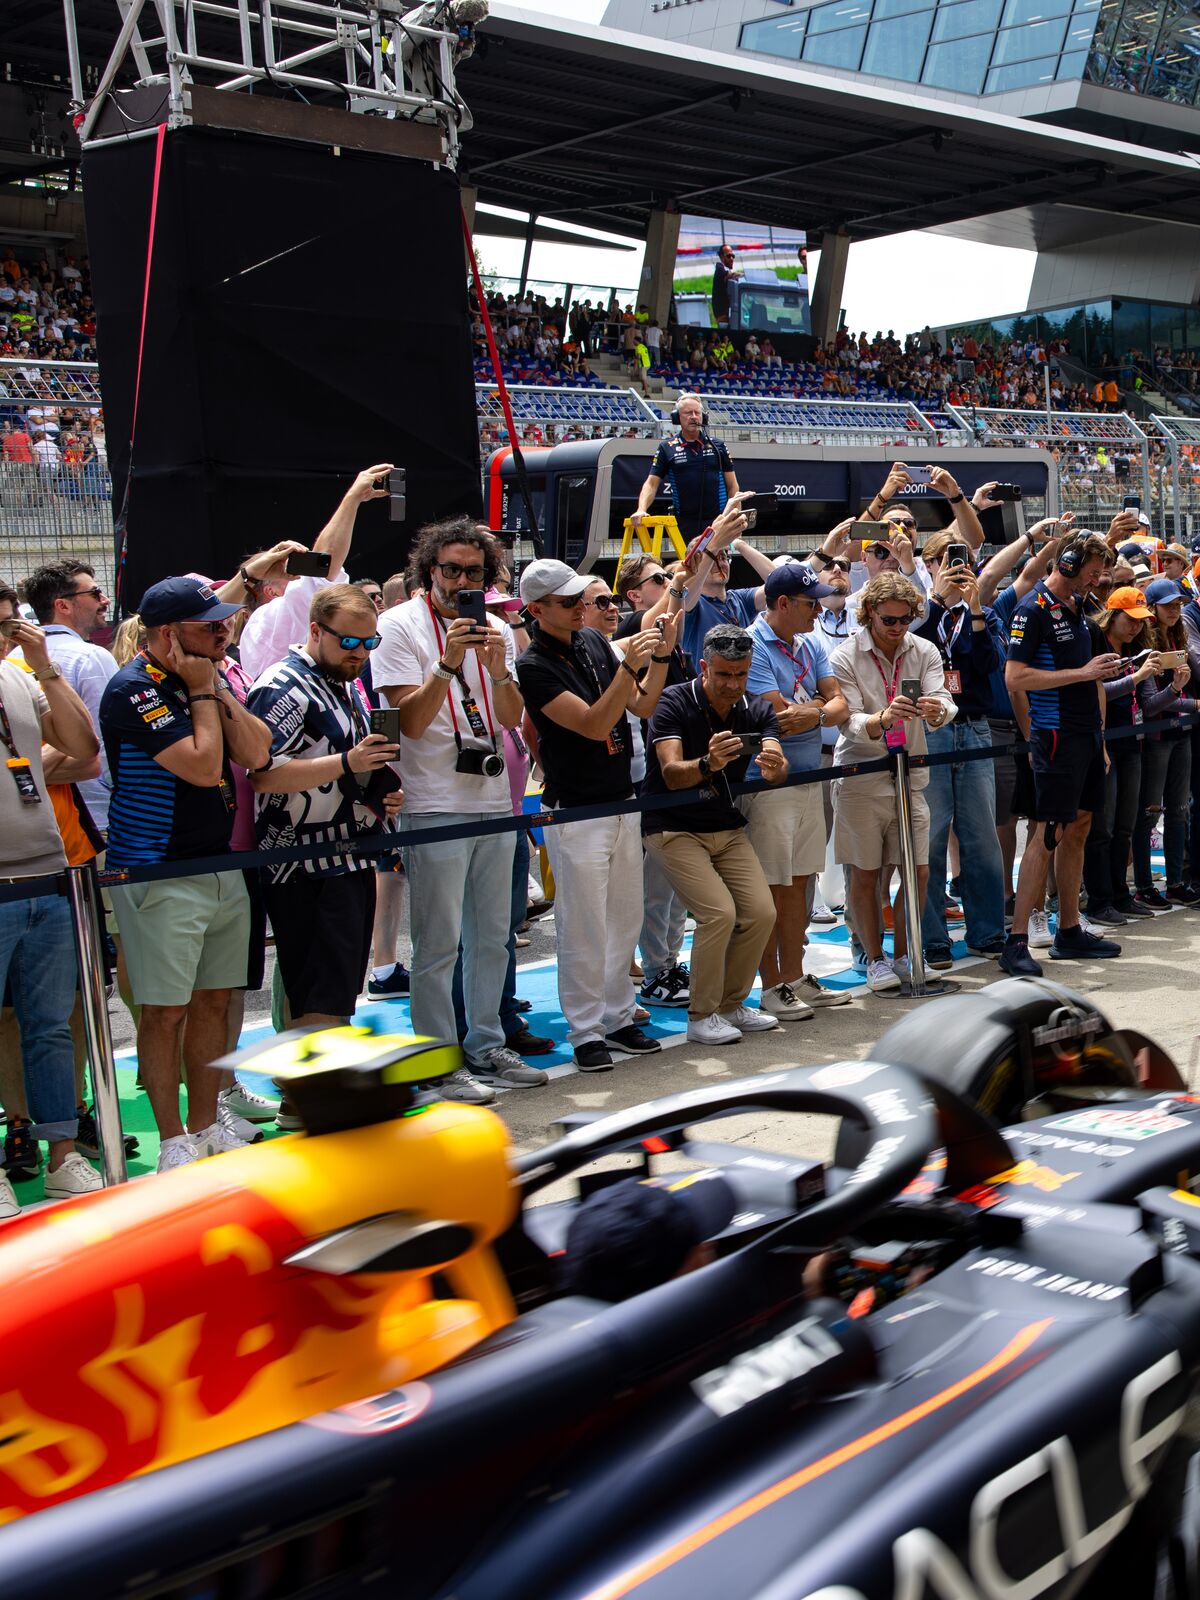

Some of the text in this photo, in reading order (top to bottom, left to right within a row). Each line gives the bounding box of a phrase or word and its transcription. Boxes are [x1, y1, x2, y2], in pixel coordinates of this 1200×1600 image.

[774, 484, 806, 497] zoom
[129, 688, 158, 705] Mobil
[137, 697, 163, 714] Claro
[265, 694, 297, 725] WORK
[97, 868, 129, 877] ORACLE
[965, 1256, 1130, 1301] PEPE JEANS
